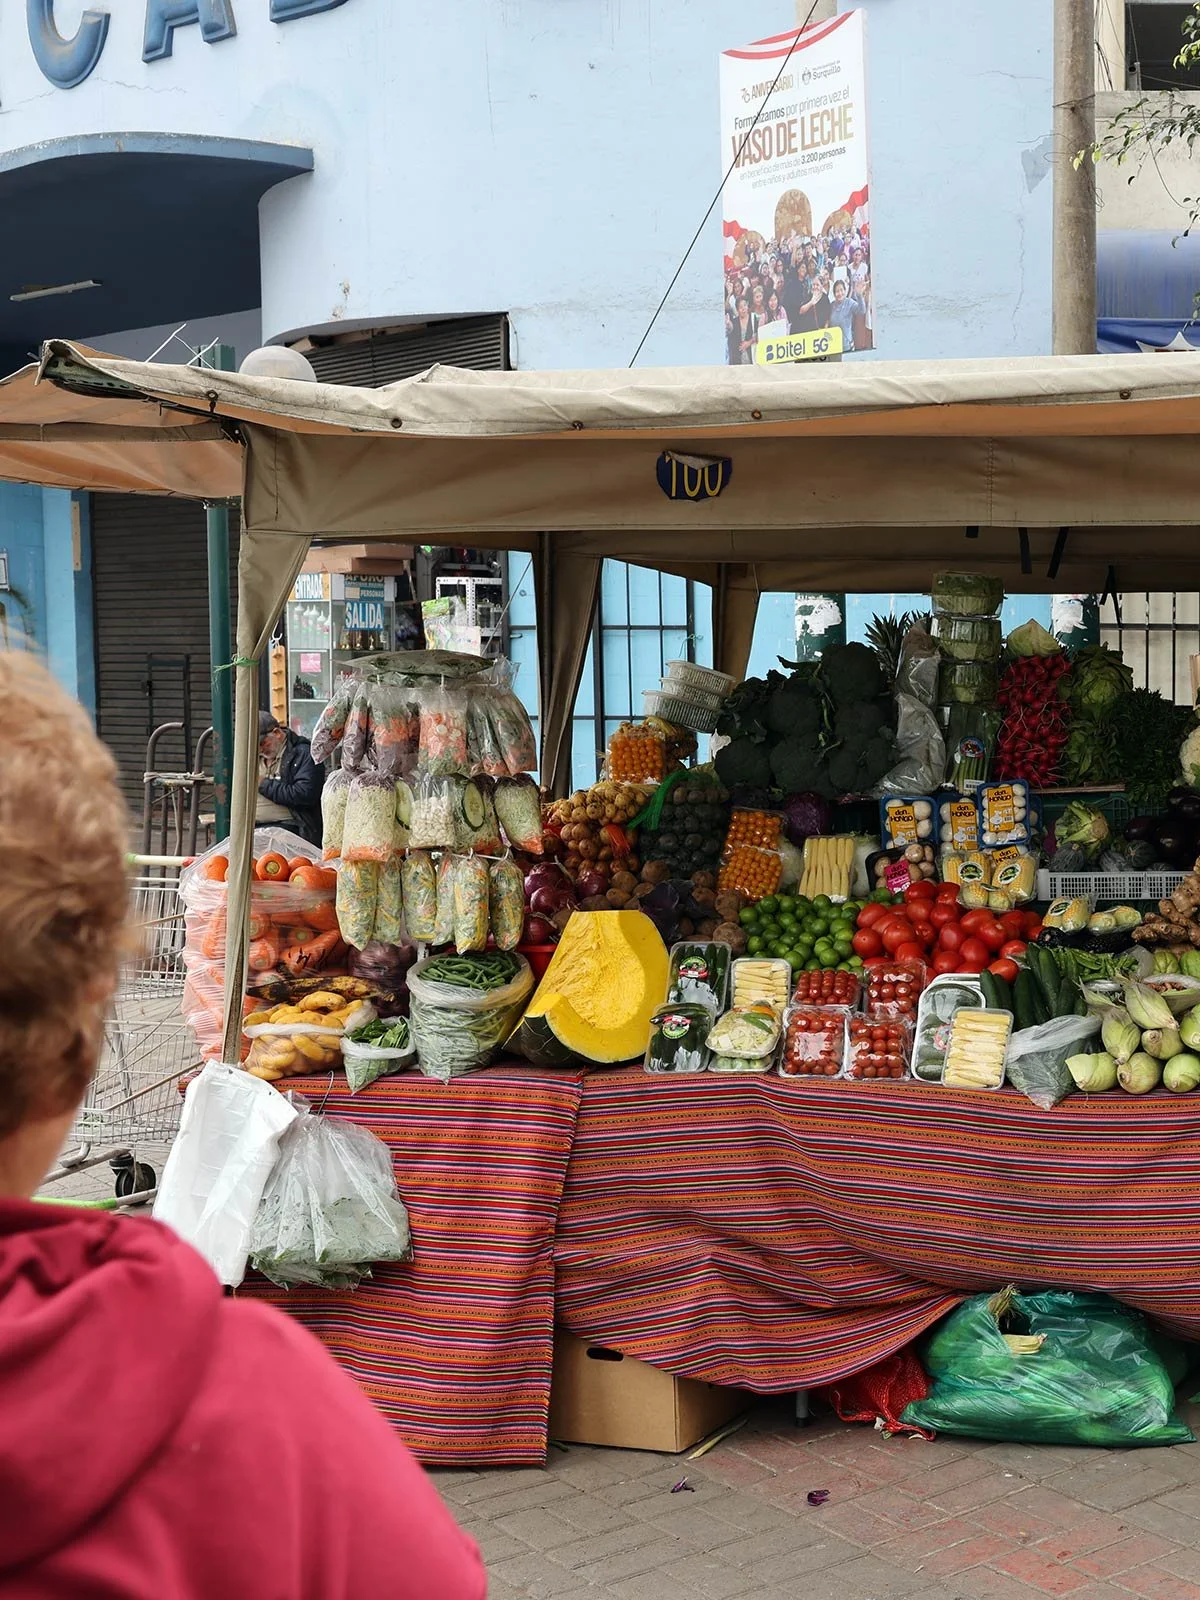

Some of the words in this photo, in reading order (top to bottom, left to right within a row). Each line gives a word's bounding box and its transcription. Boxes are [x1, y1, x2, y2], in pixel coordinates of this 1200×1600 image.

[812, 64, 841, 80] Surquillo
[751, 74, 794, 100] ANIVERSARIO
[786, 103, 798, 118] por
[799, 95, 828, 115] primera
[828, 90, 842, 103] vez
[843, 84, 850, 100] el
[731, 126, 773, 169] VASO
[776, 118, 798, 158] DE
[800, 102, 854, 151] LECHE
[819, 146, 846, 161] personas
[776, 338, 806, 359] bitel
[813, 337, 829, 354] 5G
[295, 574, 324, 599] ENTRADA
[345, 602, 384, 629] SALIDA
